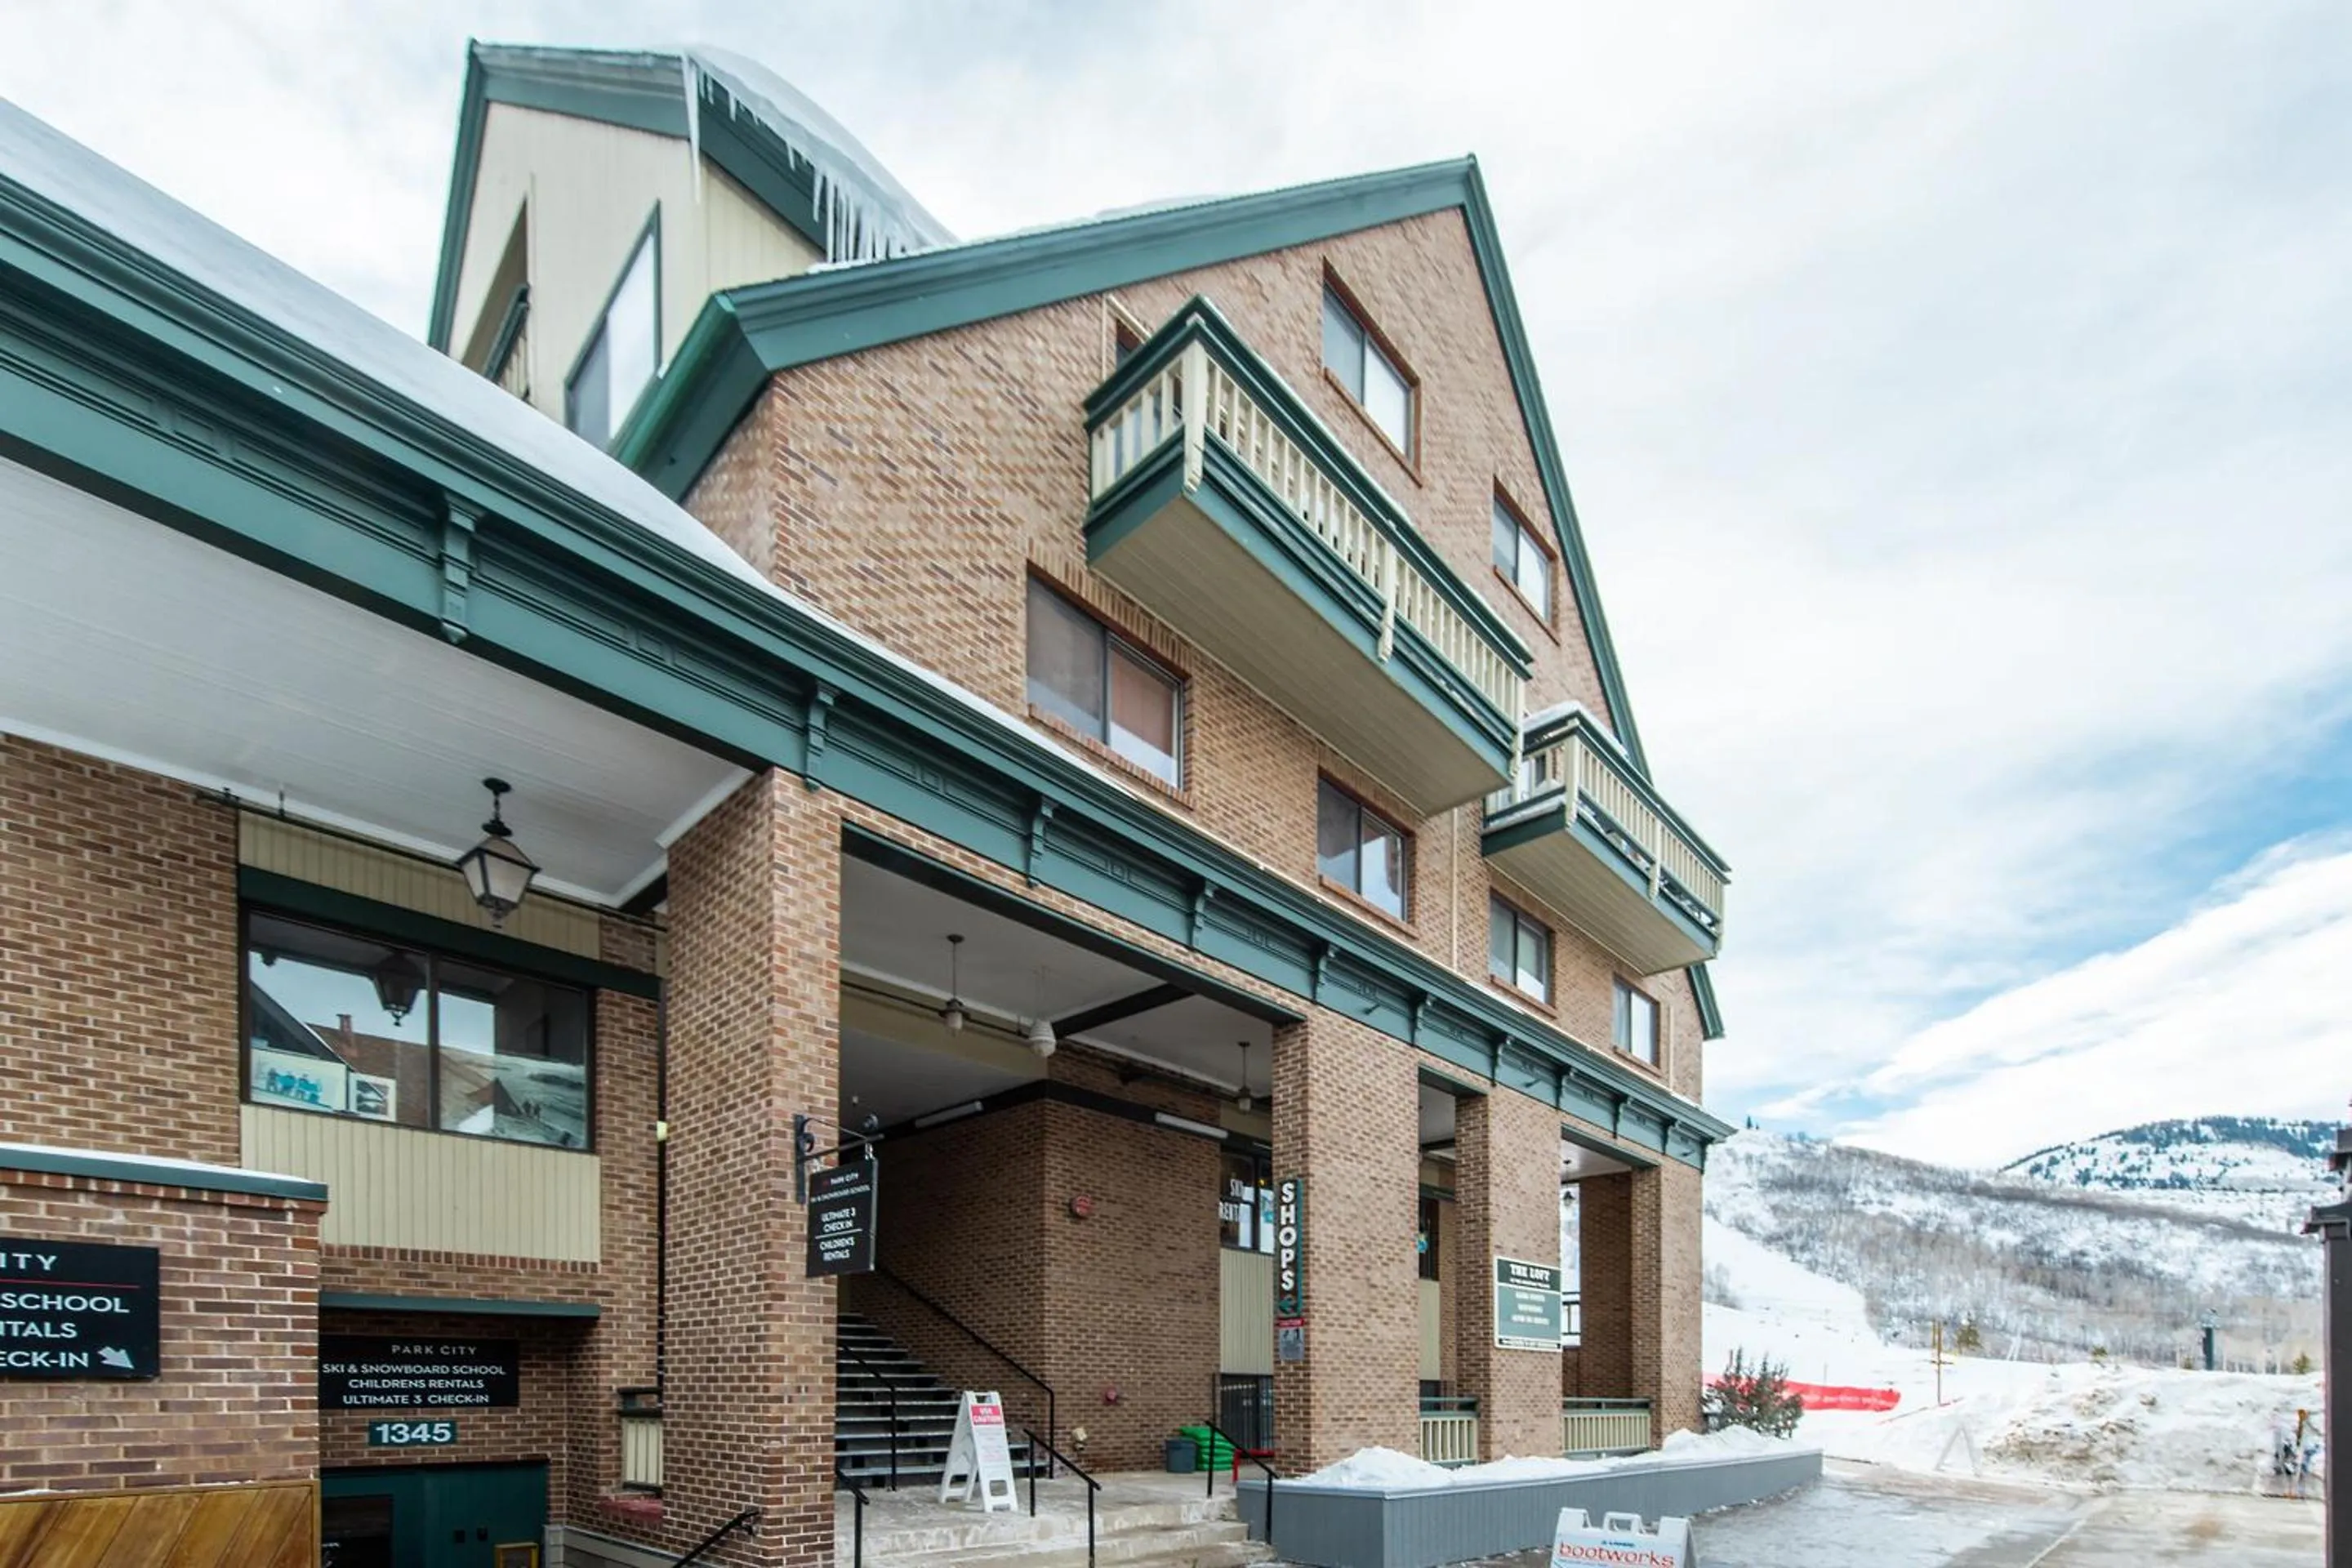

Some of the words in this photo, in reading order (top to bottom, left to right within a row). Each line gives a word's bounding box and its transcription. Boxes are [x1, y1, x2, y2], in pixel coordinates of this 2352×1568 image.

[821, 1208, 850, 1223] ULTIMATE
[850, 1207, 856, 1217] 3
[1279, 1182, 1297, 1291] SHOPS
[822, 1249, 850, 1262] RENTALS
[1510, 1263, 1528, 1277] THE
[1530, 1267, 1551, 1282] LOFT
[0, 1293, 130, 1313] SCHOOL
[391, 1345, 434, 1355] PARK
[440, 1345, 477, 1356] CITY
[323, 1363, 345, 1374] SKI
[347, 1363, 358, 1374] &
[360, 1363, 449, 1374] SNOWBOARD
[452, 1365, 506, 1375] SCHOOL
[349, 1379, 425, 1389] CHILDRENS
[429, 1379, 484, 1389] RENTALS
[342, 1394, 409, 1405] ULTIMATE
[413, 1394, 422, 1404] 3
[427, 1393, 490, 1404] CHECK-IN
[375, 1423, 452, 1444] 1345
[1559, 1539, 1675, 1568] bootworks
